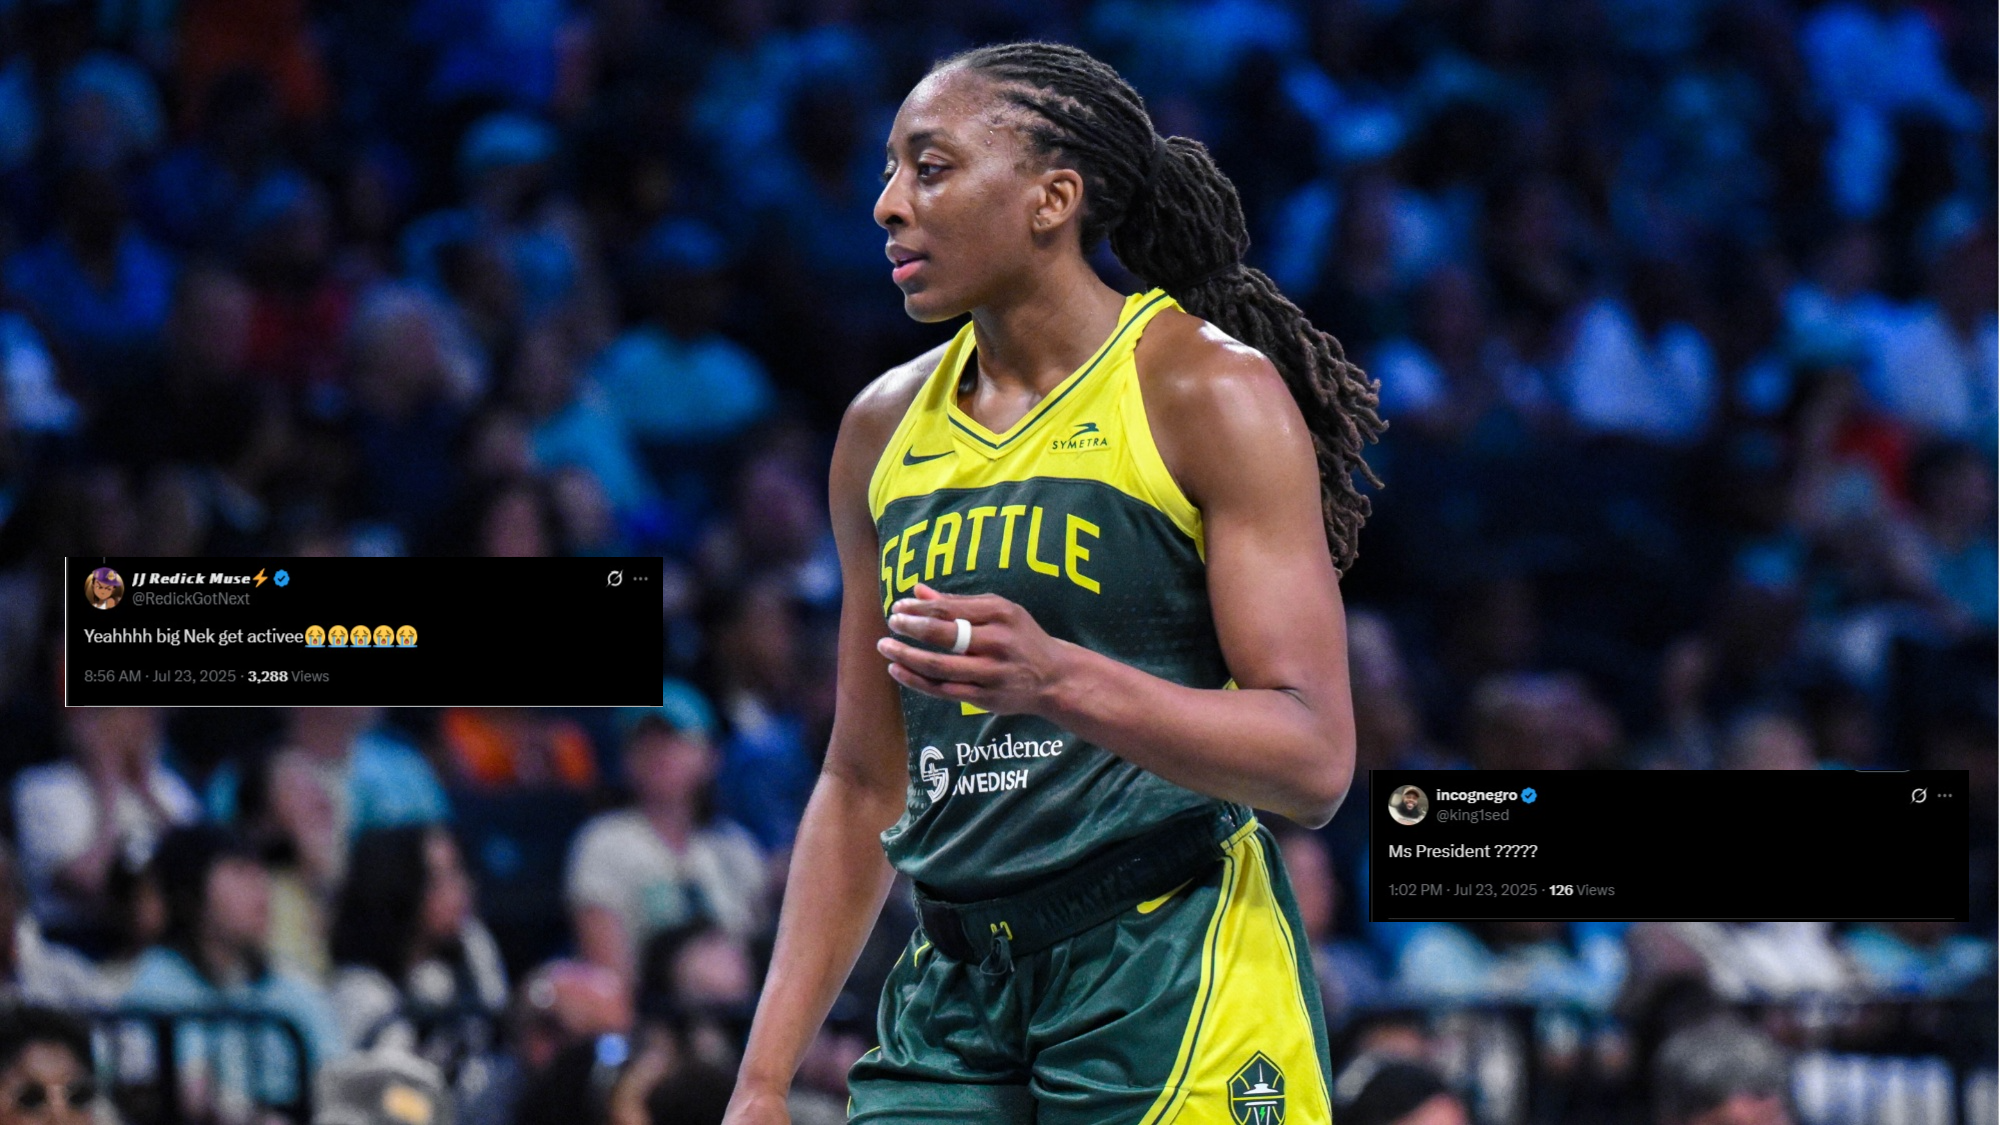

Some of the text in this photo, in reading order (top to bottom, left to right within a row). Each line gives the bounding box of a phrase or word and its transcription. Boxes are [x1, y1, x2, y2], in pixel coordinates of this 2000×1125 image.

[1051, 437, 1109, 450] SYMETRA
[881, 504, 1100, 617] SEATTLE
[955, 733, 1063, 767] Povidence
